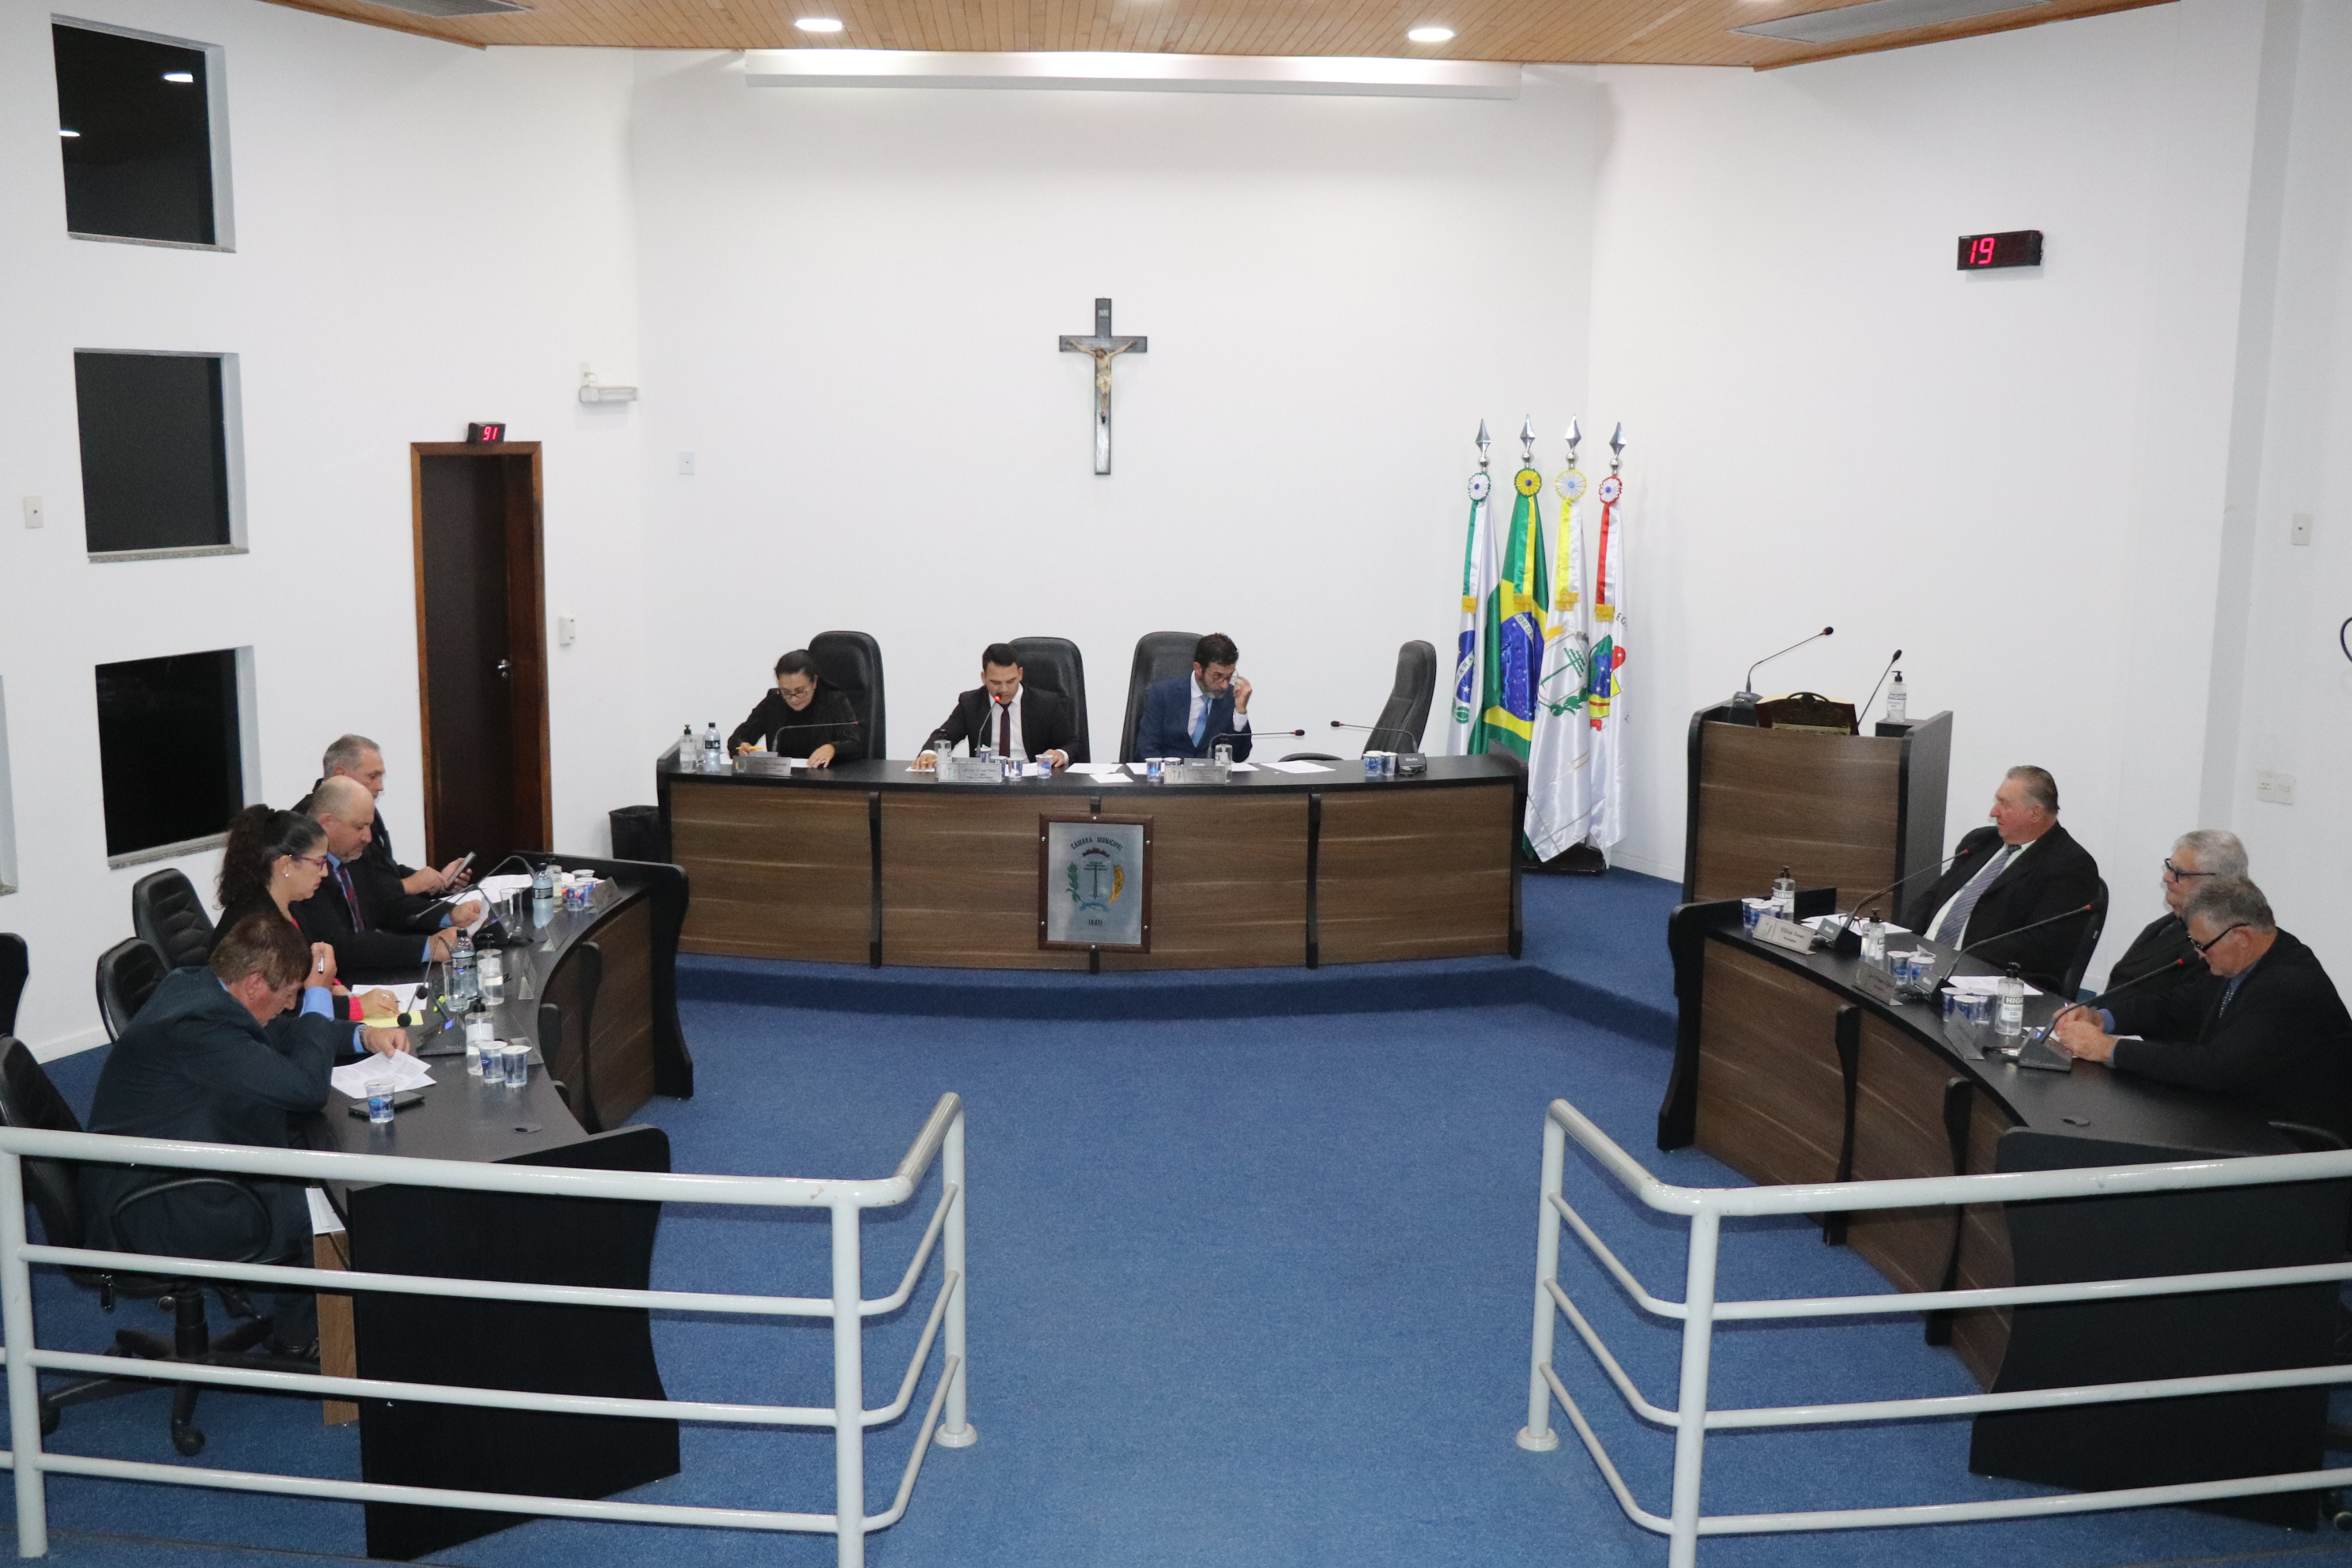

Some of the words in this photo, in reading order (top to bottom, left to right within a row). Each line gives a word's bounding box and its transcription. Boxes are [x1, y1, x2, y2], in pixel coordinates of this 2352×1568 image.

[1969, 237, 1996, 265] 19
[482, 426, 499, 441] 91
[1096, 836, 1124, 851] MUNICIPAL
